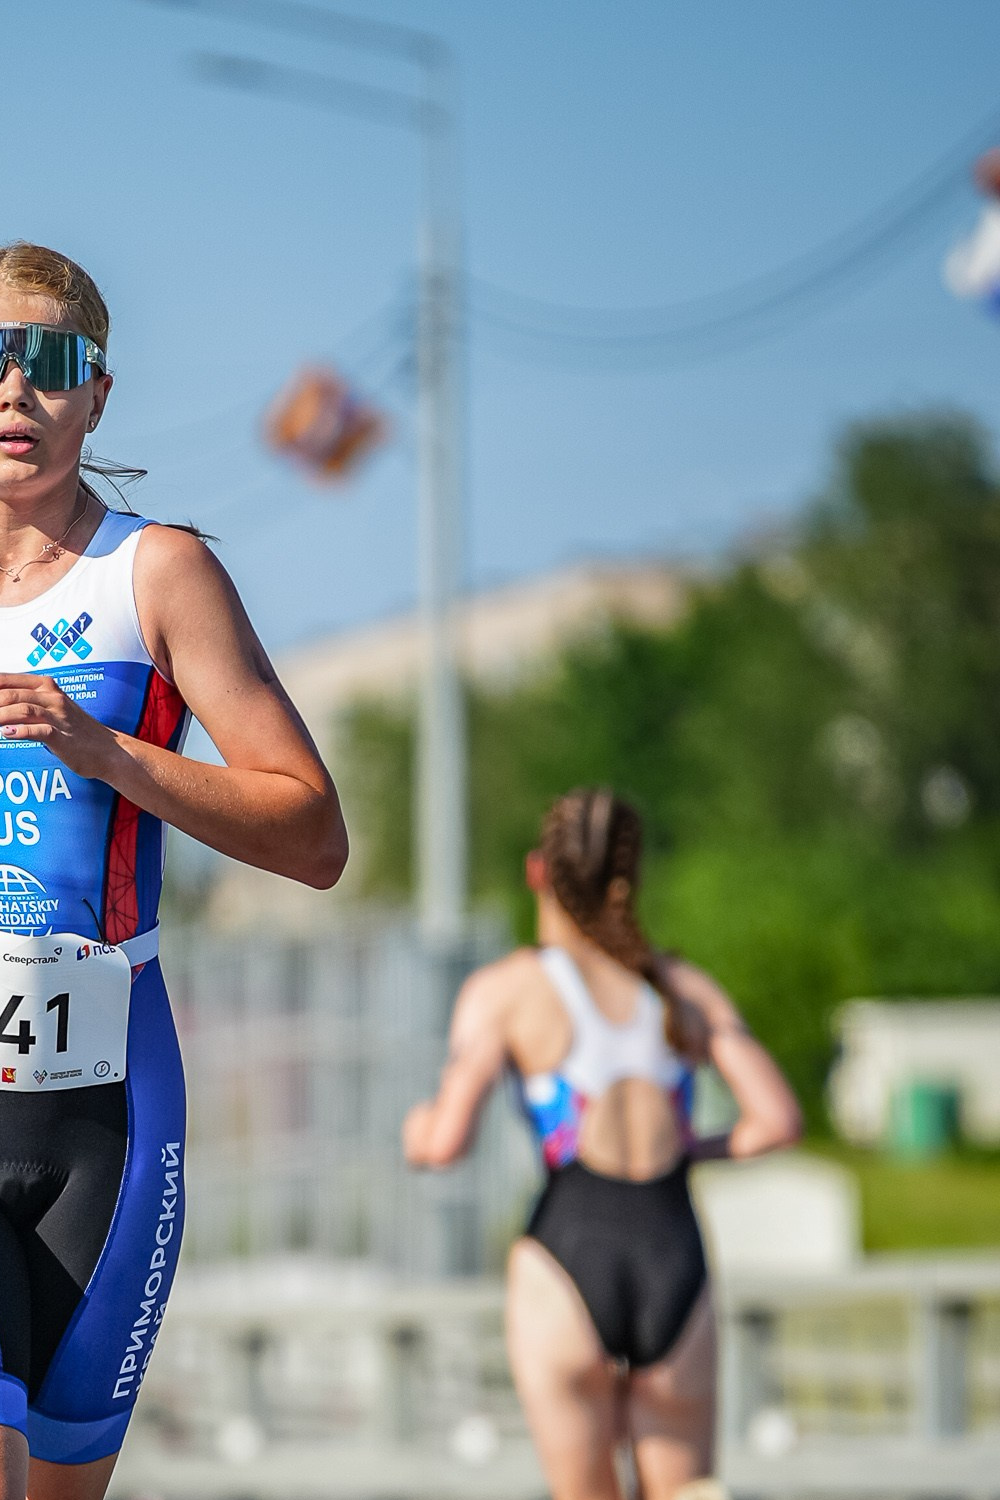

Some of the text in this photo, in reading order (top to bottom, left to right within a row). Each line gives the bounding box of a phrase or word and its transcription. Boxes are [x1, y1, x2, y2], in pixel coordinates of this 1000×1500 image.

[60, 673, 105, 685] ТРИАТЛОНА
[59, 683, 87, 693] ТЛОНА
[75, 690, 97, 700] КРАЯ
[2, 953, 60, 966] Северсталь
[112, 1141, 181, 1400] ПРИМОРСКИЙ
